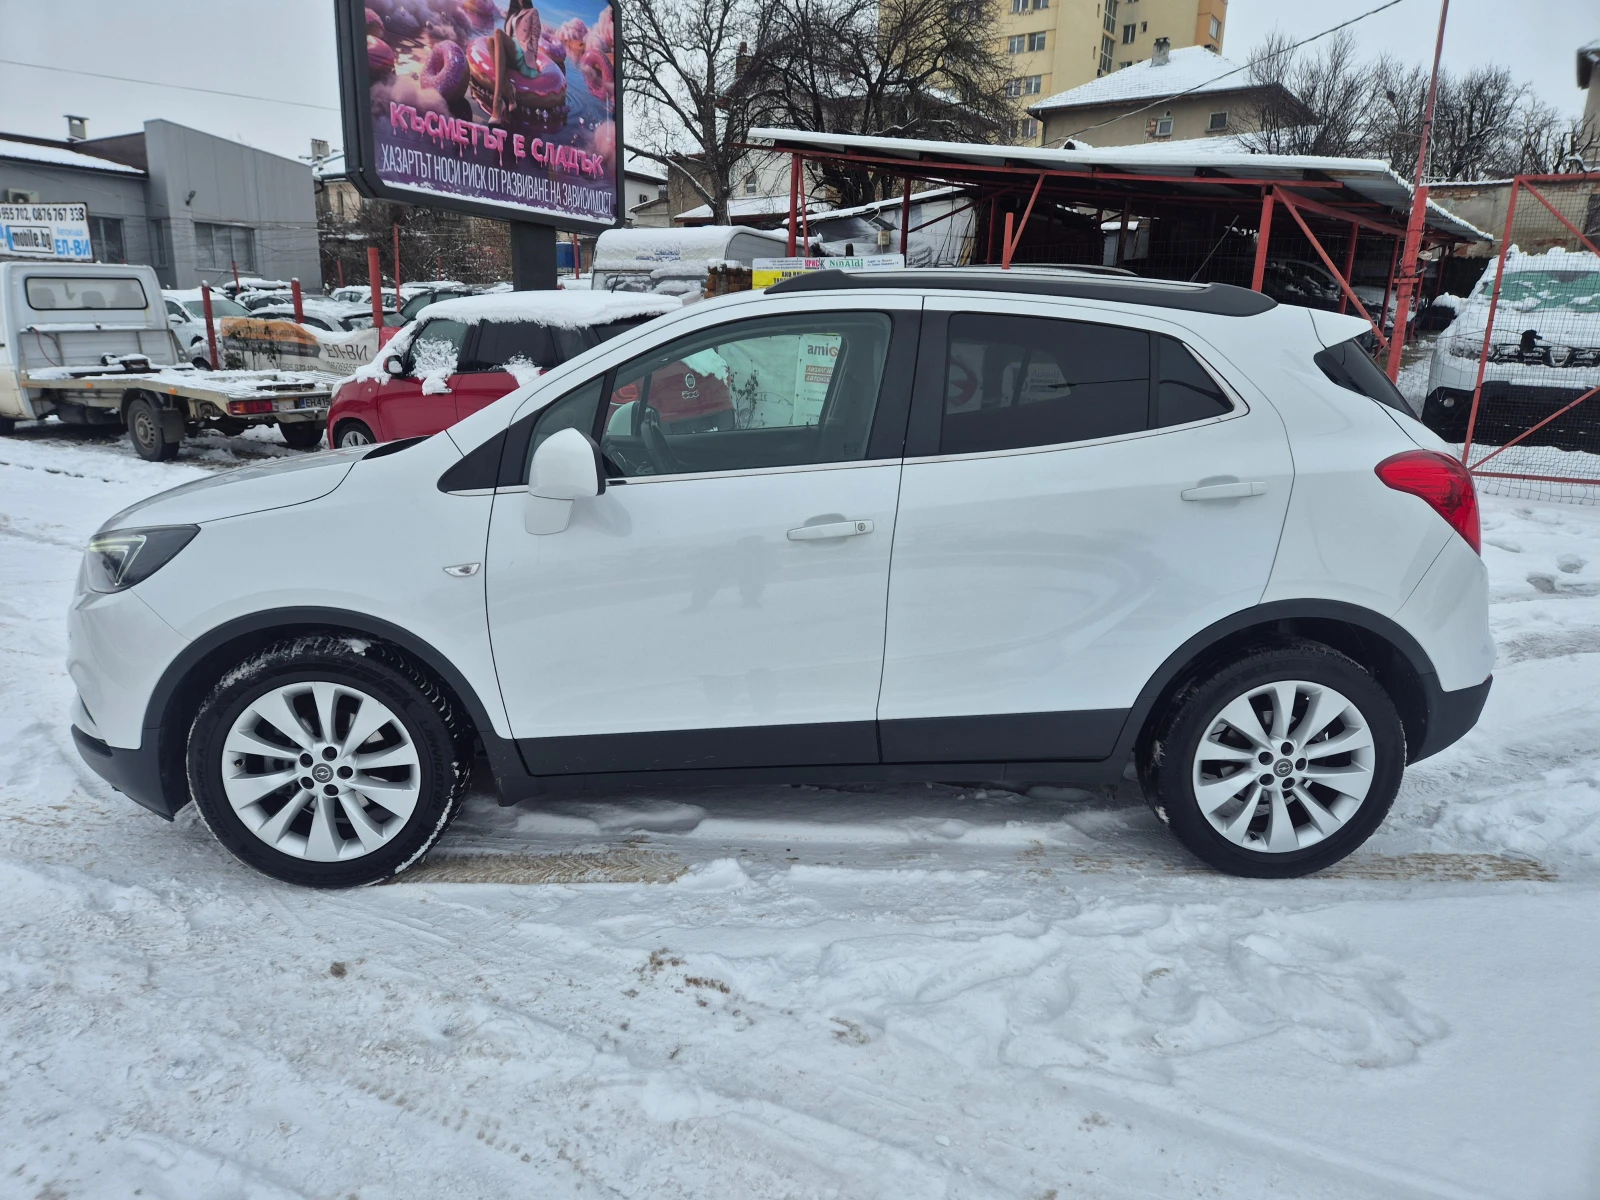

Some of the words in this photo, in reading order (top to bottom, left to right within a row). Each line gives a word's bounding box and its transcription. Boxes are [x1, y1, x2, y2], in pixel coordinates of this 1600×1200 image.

[390, 101, 507, 153] КЪСМЕТЪТ
[513, 134, 526, 160] Е
[531, 138, 604, 176] СЛАДЪК
[381, 143, 432, 179] ХАЗАРТЪТ
[434, 157, 461, 186] НОСИ
[462, 162, 487, 190] РИСК
[488, 167, 500, 192] ОТ
[501, 170, 549, 203] РАЗВИВАНЕ
[550, 180, 562, 203] НА
[562, 182, 613, 214] ЗАВИСИМОСТ
[32, 207, 52, 221] 0876
[53, 208, 67, 221] 767
[12, 229, 52, 251] mobile.bg
[54, 238, 91, 256] ЕЛ-ВИ
[323, 343, 369, 362] ЕЛ-ВИ
